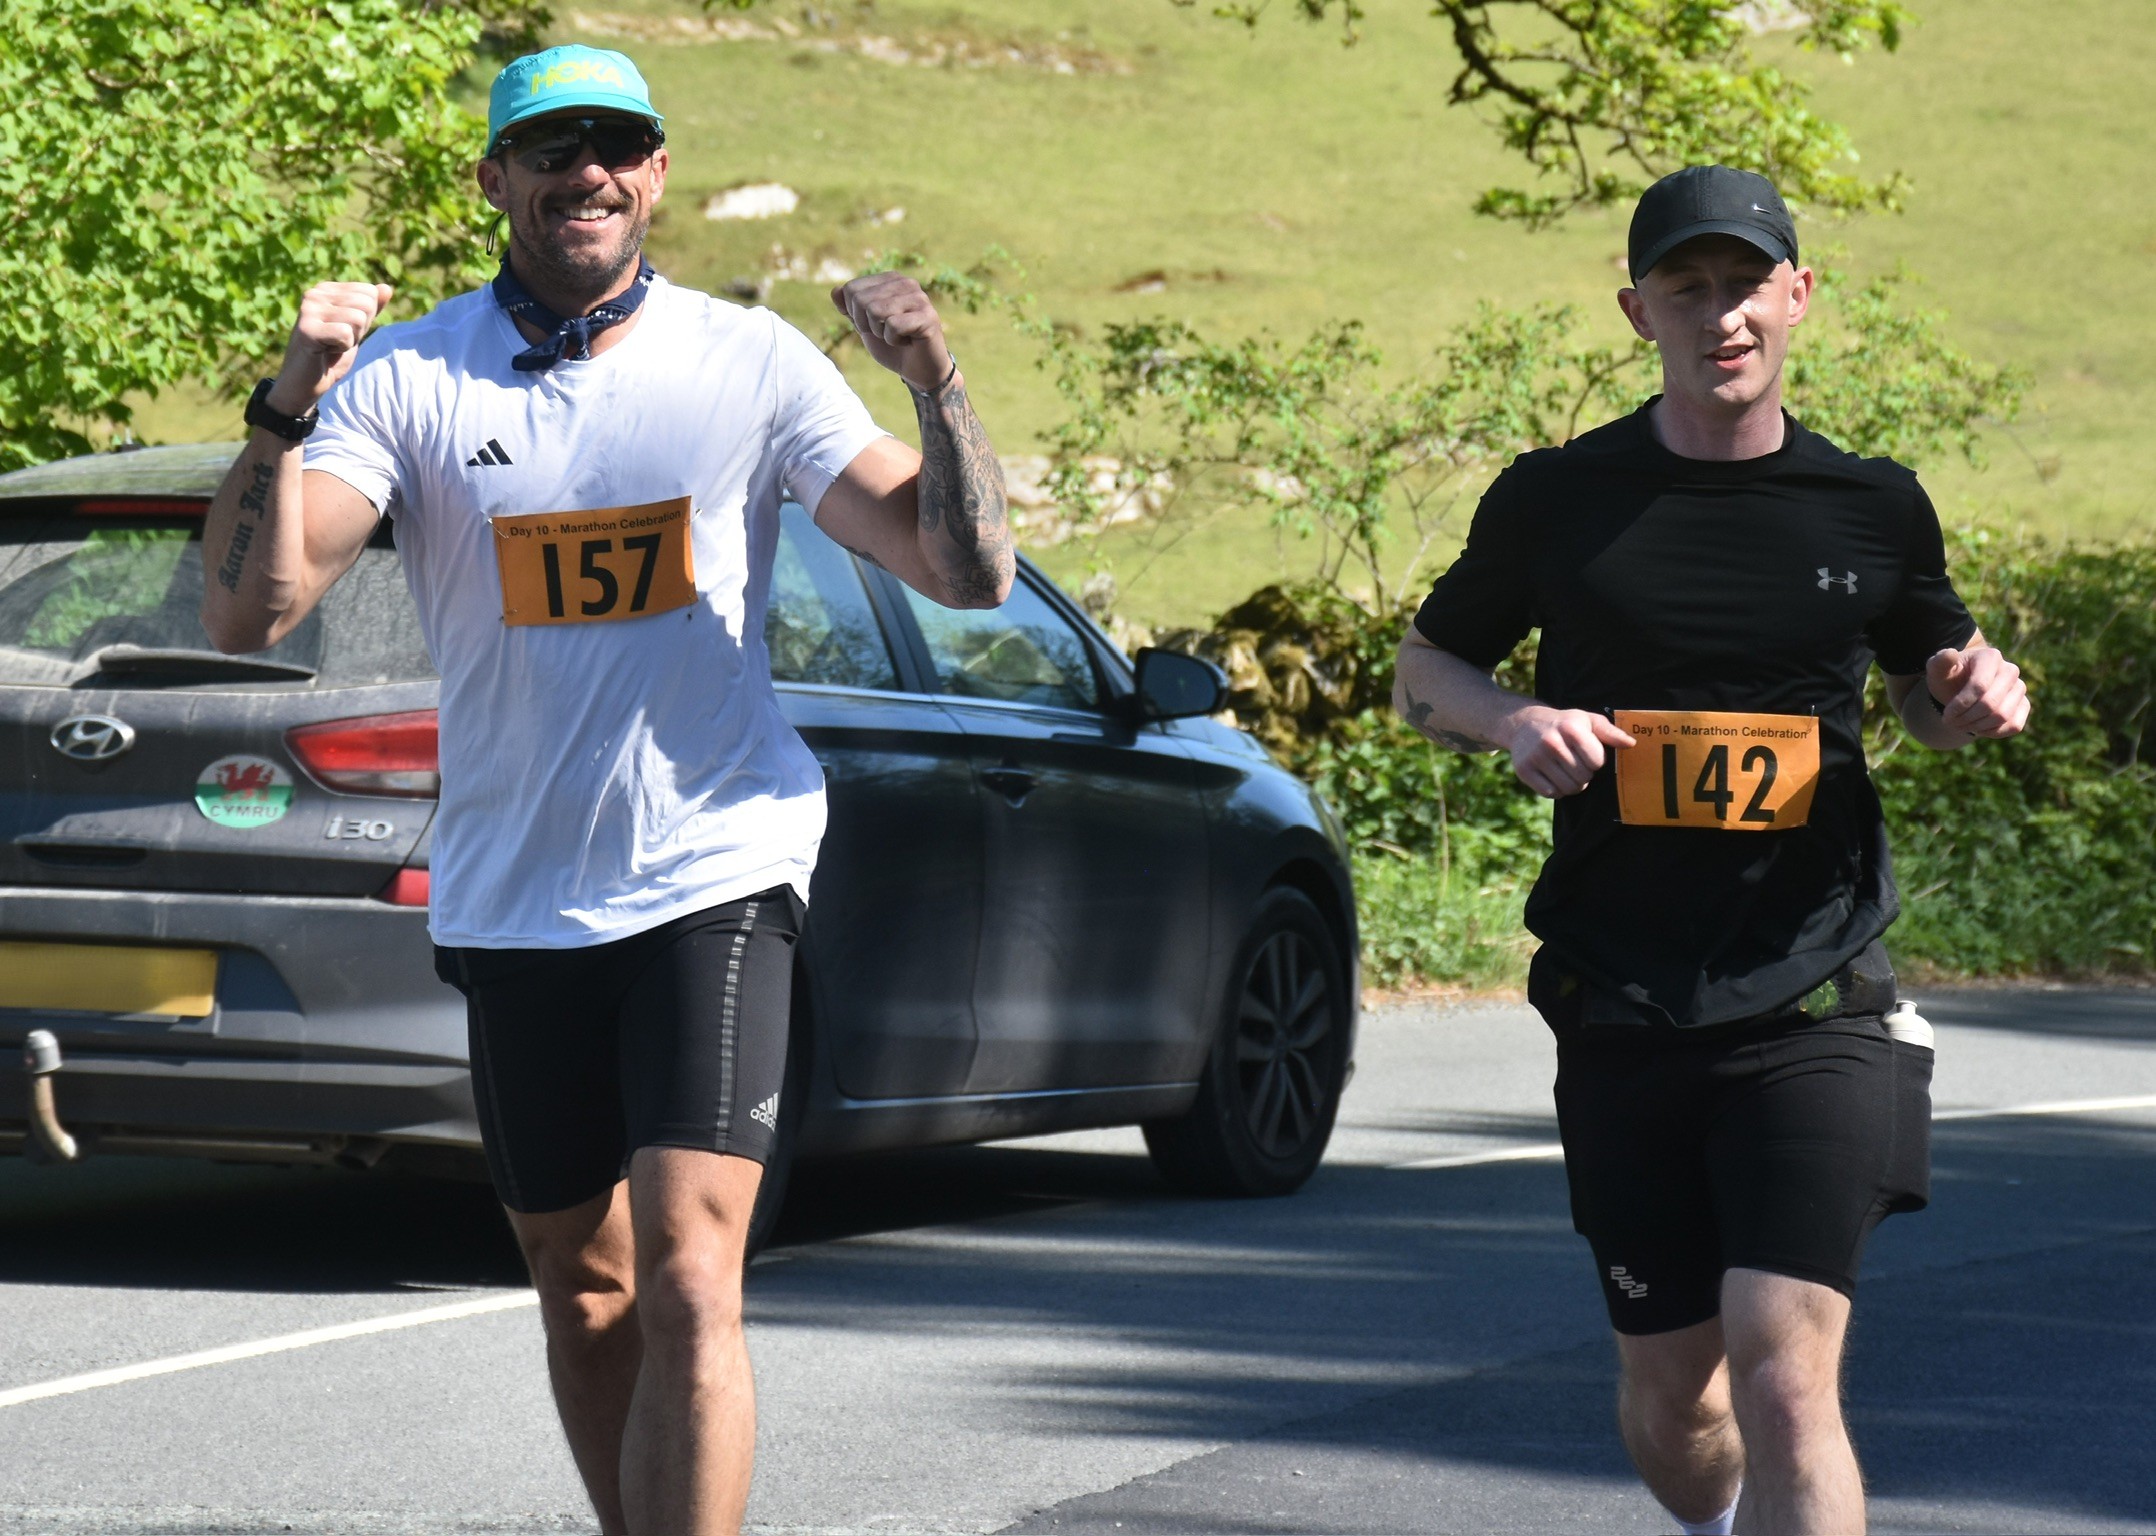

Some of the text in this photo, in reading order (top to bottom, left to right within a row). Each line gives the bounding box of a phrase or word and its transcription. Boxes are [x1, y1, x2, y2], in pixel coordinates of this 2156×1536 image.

[531, 61, 624, 96] HOKA
[510, 526, 532, 538] Day
[536, 525, 549, 536] 10
[560, 520, 617, 534] Marathon
[620, 509, 682, 529] Celebration
[542, 532, 662, 618] 157
[1632, 724, 1653, 736] Day
[1657, 725, 1670, 735] 10
[1681, 725, 1738, 736] Marathon
[1742, 727, 1808, 739] Celebration
[1662, 743, 1779, 823] 142
[209, 804, 280, 819] CYMRU
[325, 814, 394, 841] i30
